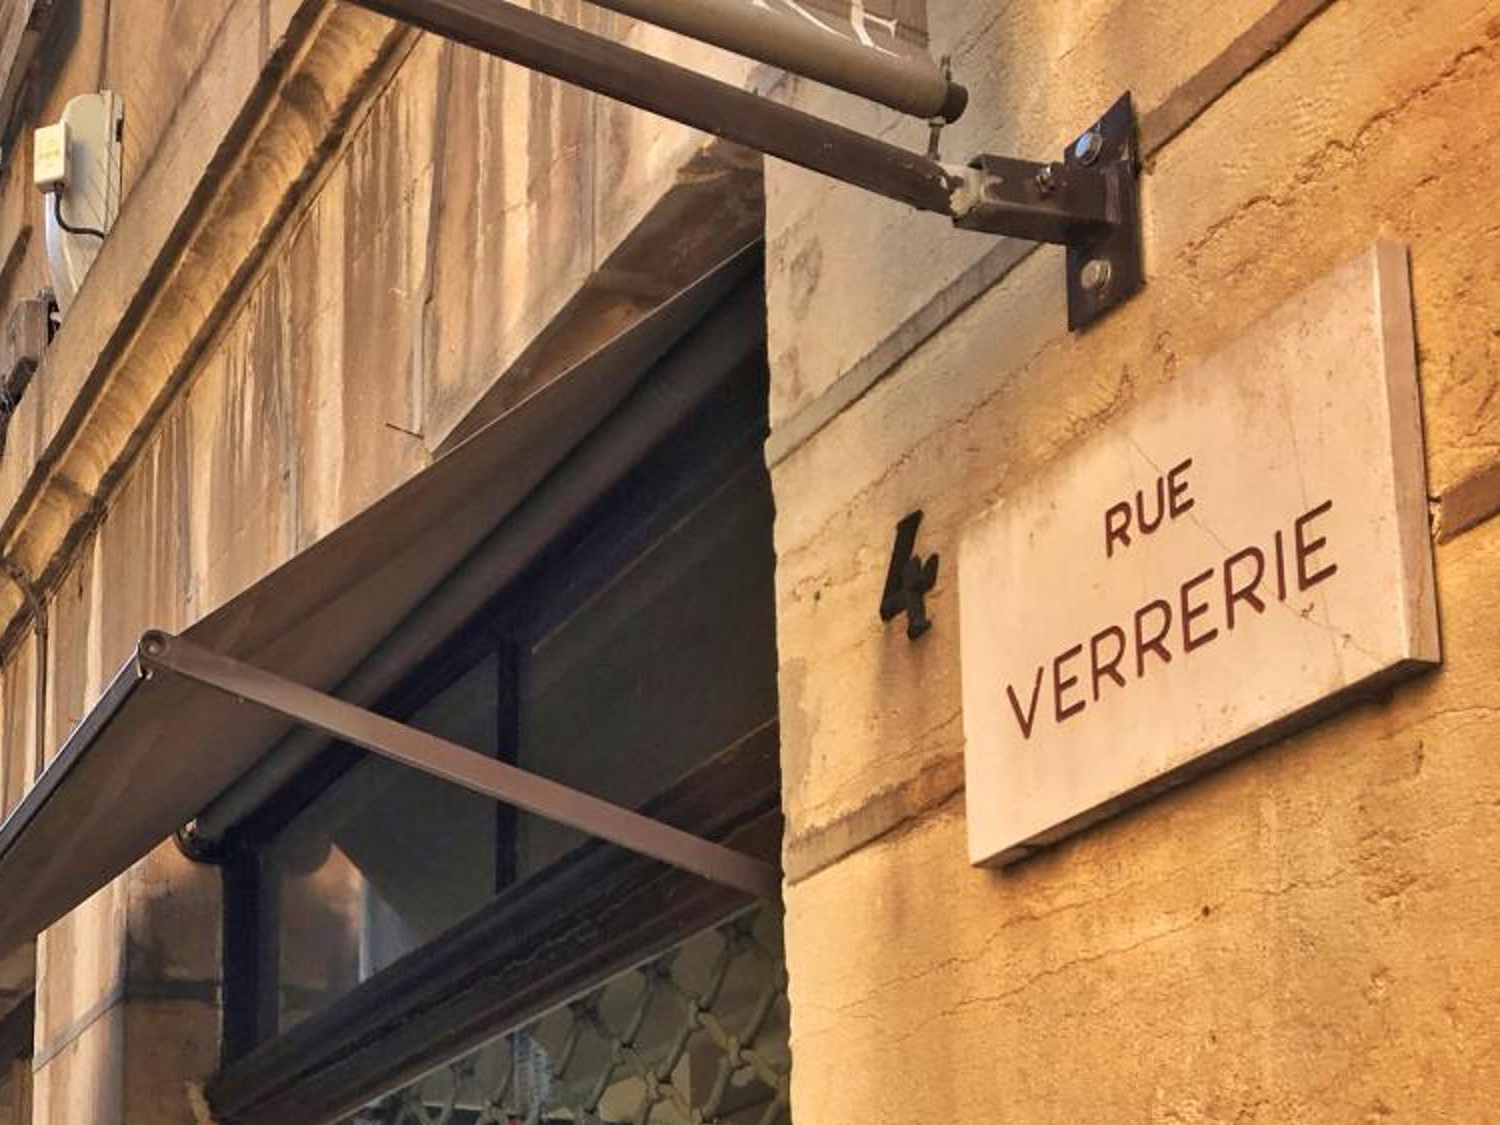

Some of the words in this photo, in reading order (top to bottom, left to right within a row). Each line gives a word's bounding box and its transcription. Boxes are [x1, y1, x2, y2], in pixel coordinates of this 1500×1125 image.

[1105, 457, 1196, 558] RUE
[879, 509, 940, 641] 4
[1006, 500, 1338, 739] VERRERIE
